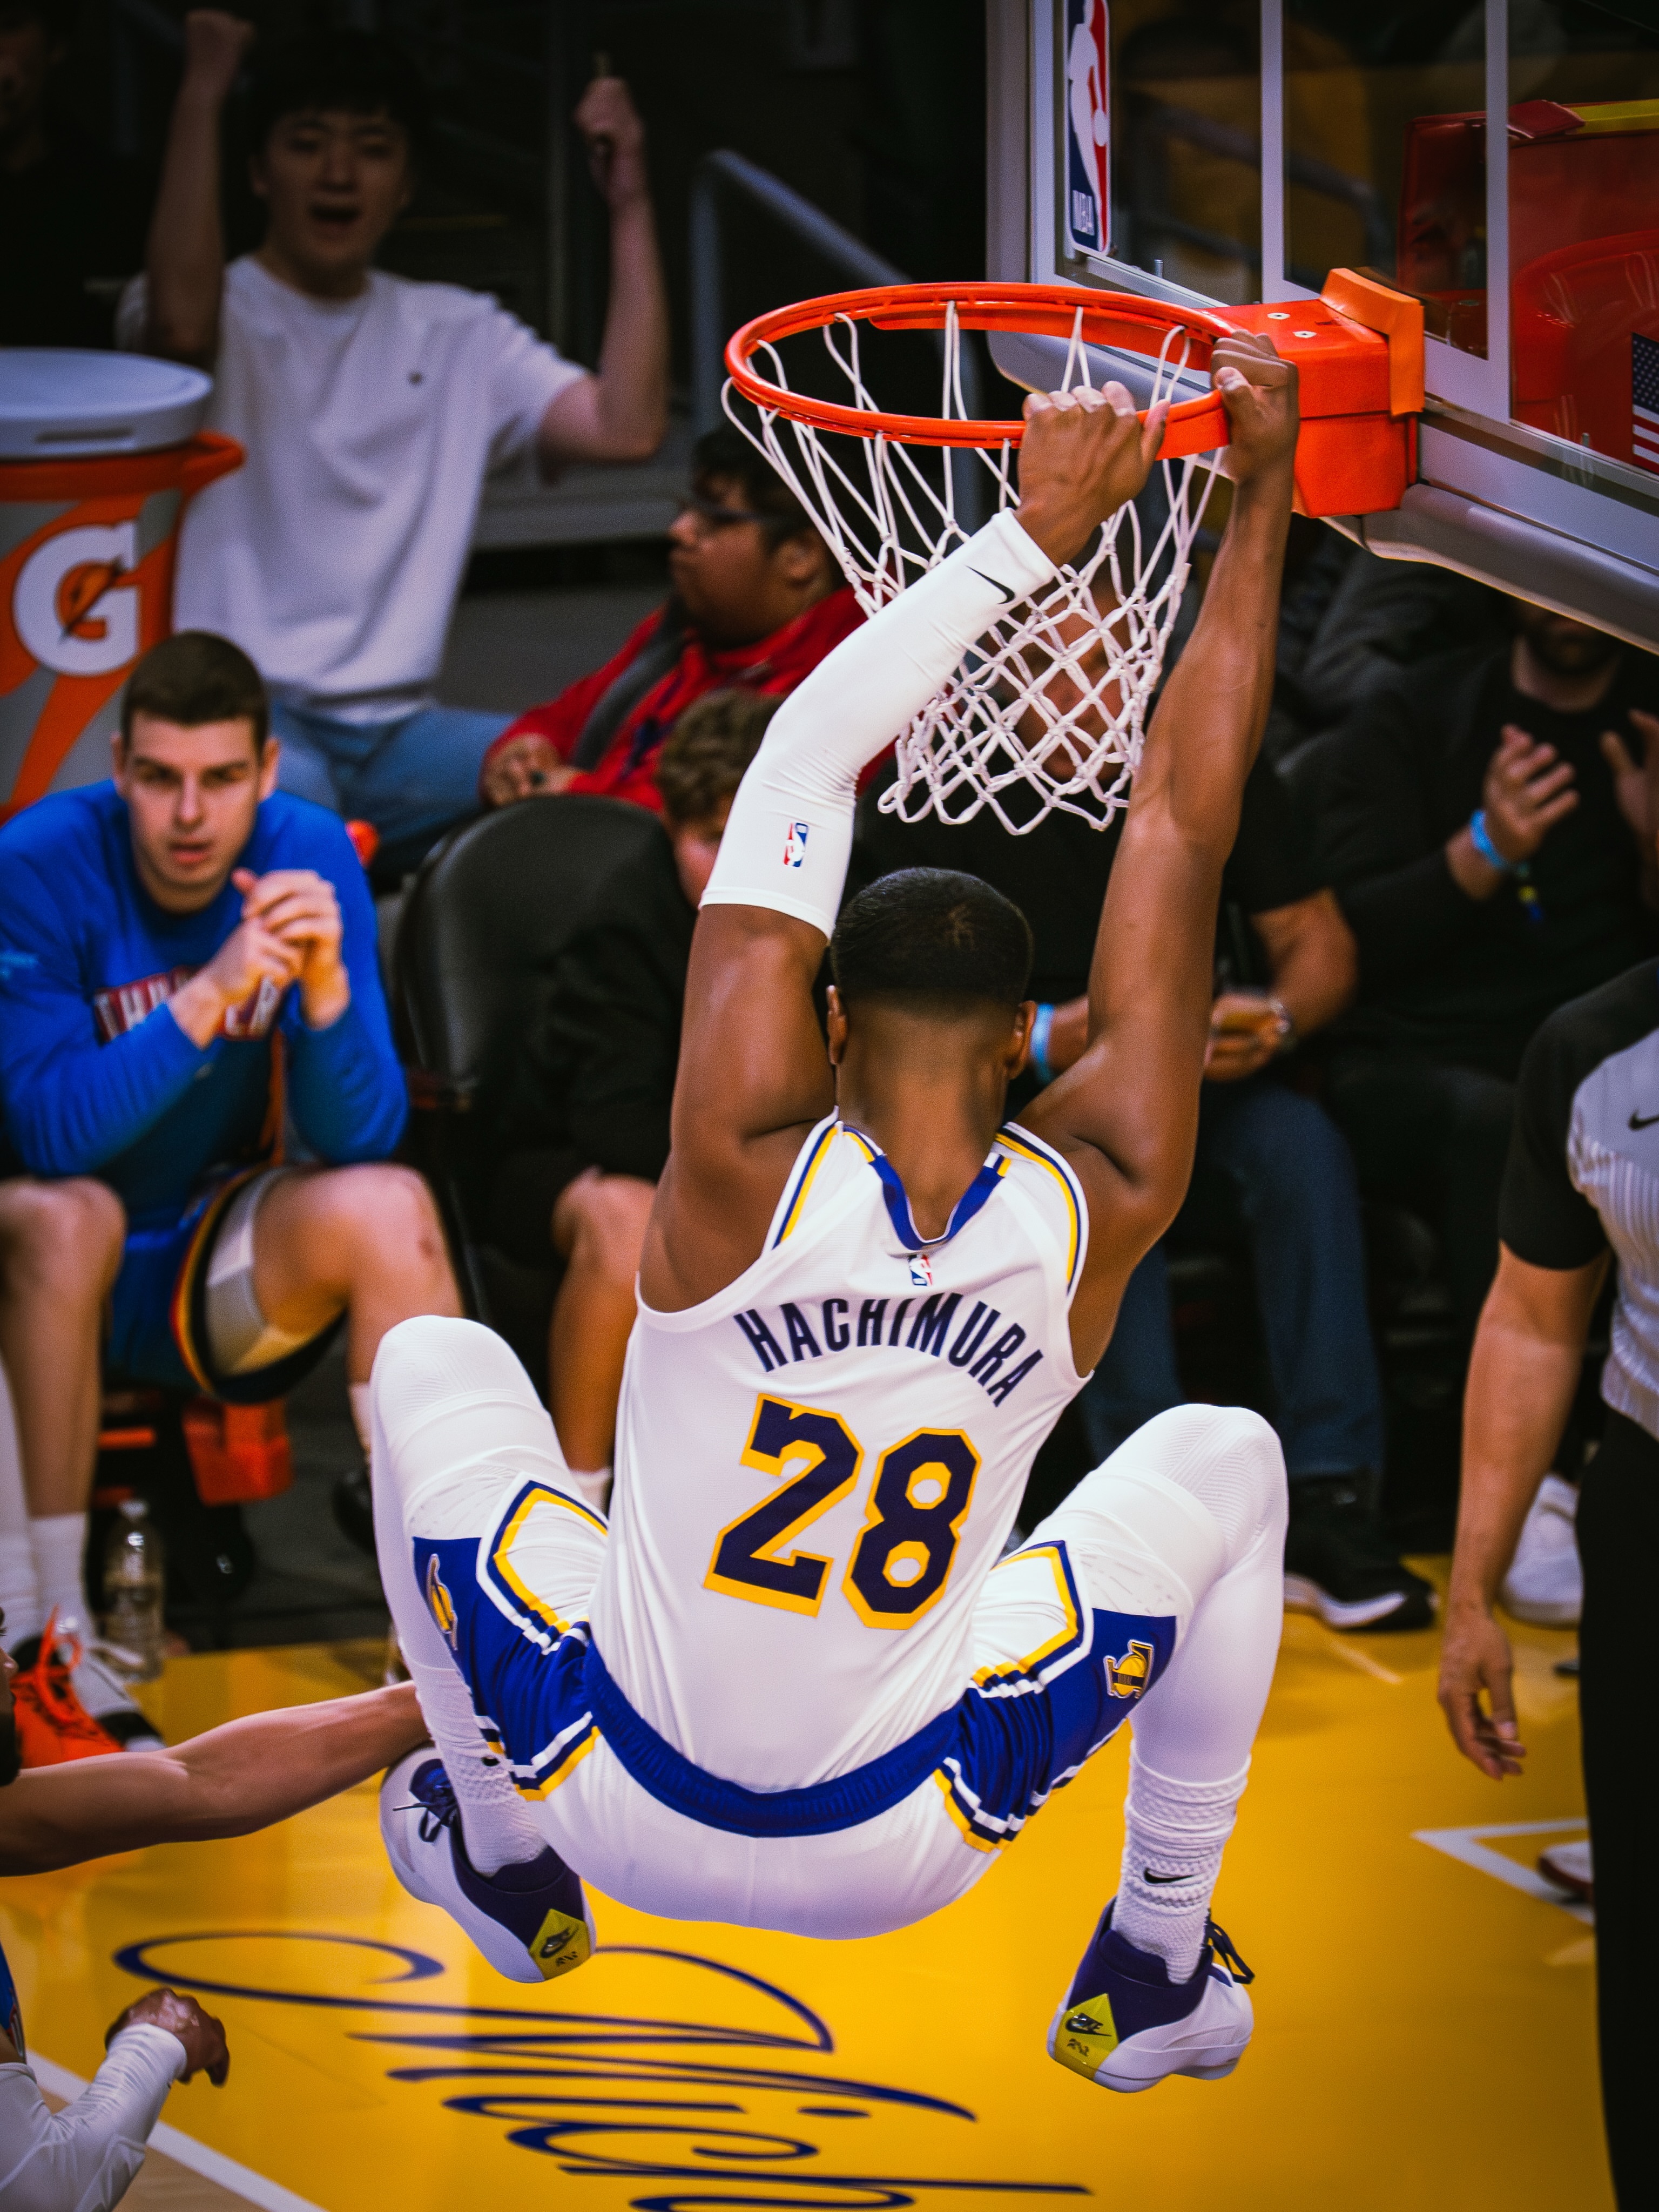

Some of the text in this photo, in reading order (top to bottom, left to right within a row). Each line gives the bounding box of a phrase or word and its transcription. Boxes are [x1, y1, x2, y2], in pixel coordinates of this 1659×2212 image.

[12, 519, 139, 677] G
[733, 1292, 1044, 1407] HACHIMURA
[703, 1392, 982, 1630] 28
